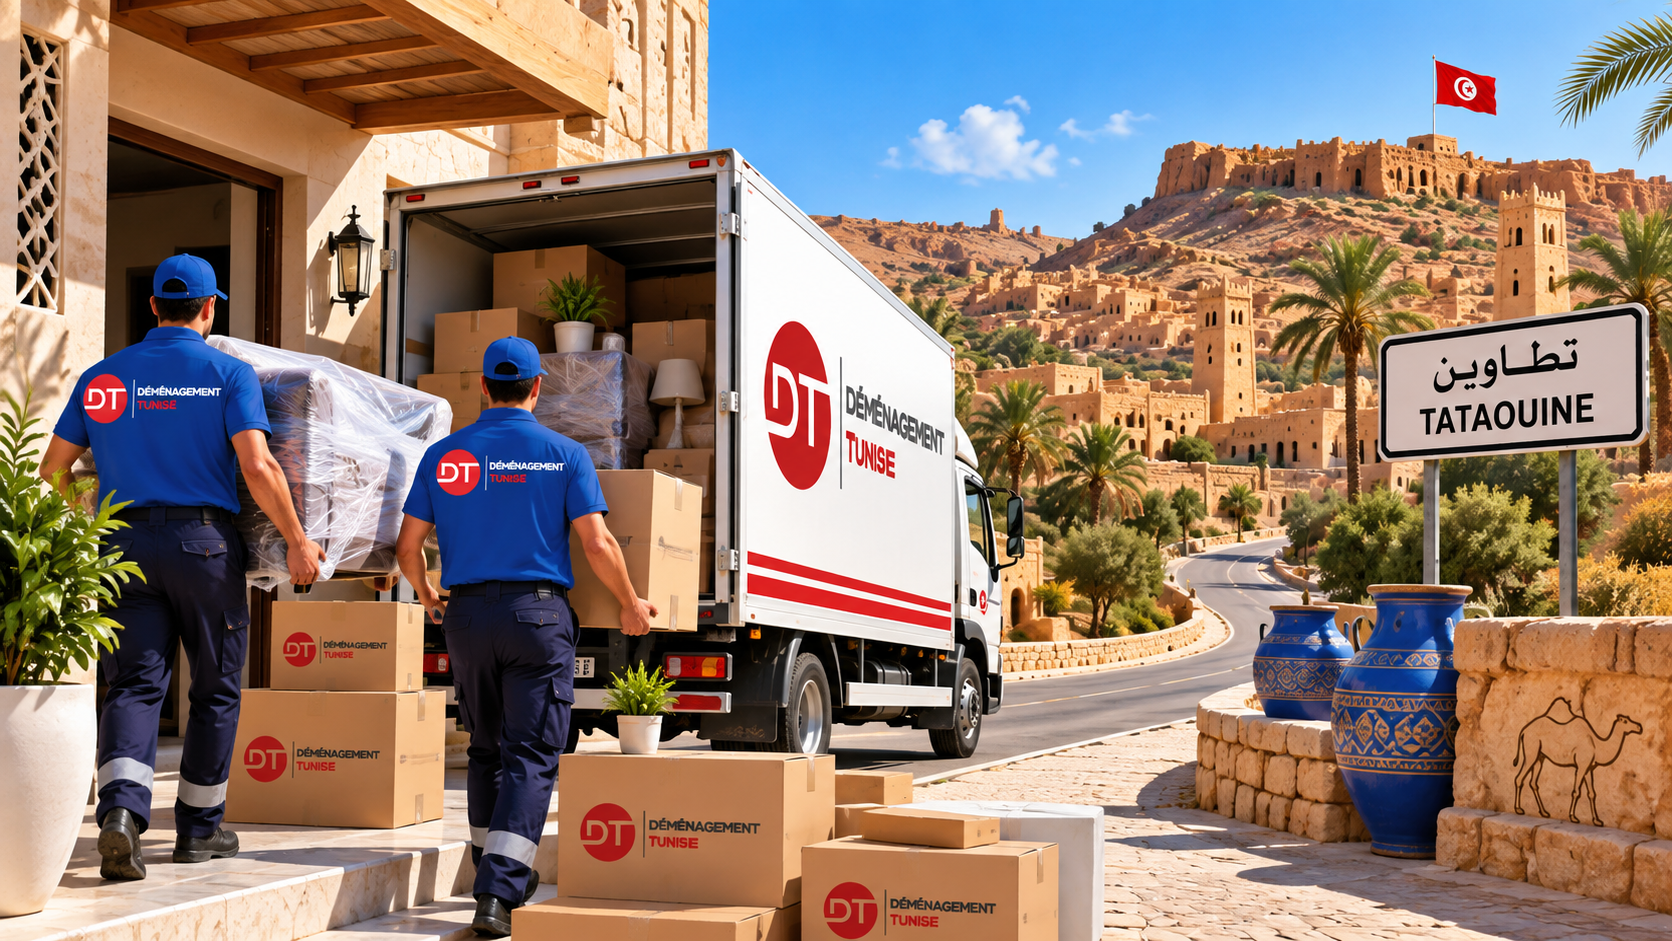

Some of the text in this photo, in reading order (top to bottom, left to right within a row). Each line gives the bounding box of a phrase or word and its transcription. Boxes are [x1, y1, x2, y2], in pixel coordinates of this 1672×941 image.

[1433, 338, 1578, 393] تطاوين
[84, 387, 127, 410] DT
[137, 385, 222, 397] DÉMÉNAGEMENT
[137, 400, 177, 410] TUNISE
[766, 362, 831, 448] DT
[846, 385, 945, 456] DÉMÉNAGEMENT
[1419, 393, 1595, 435] TATAOUINE
[846, 430, 896, 479] TUNISE
[437, 462, 480, 483] DT
[489, 460, 565, 471] DÉMÉNAGEMENT
[284, 642, 316, 658] DT
[323, 640, 388, 650] DÉMÉNAGEMENT
[244, 749, 287, 770] DT
[296, 747, 380, 760] DÉMÉNAGEMENT
[296, 761, 336, 771] TUNISE
[581, 820, 635, 846] DT
[648, 818, 761, 834] DÉMÉNAGEMENT
[648, 835, 699, 849] TUNISE
[824, 898, 878, 924] DT
[890, 897, 997, 914] DÉMÉNAGEMENT
[890, 914, 939, 928] TUNISE
